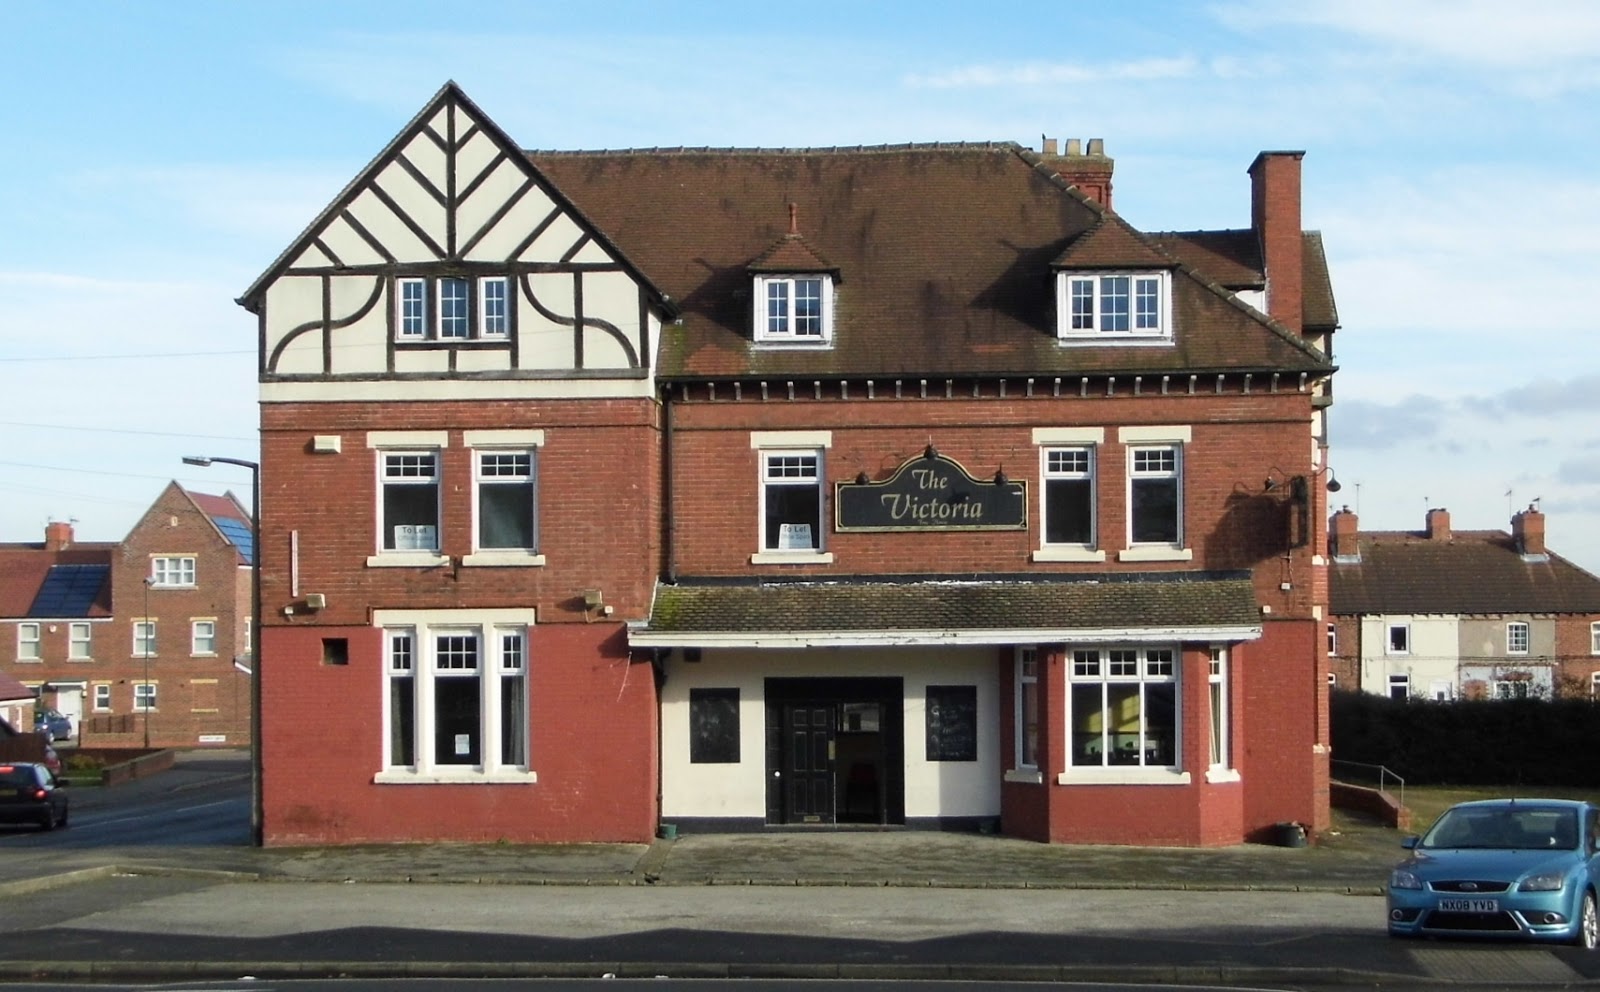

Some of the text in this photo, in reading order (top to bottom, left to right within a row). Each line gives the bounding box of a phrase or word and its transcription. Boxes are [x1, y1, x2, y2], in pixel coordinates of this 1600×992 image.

[911, 469, 948, 489] The
[880, 493, 983, 519] Victoria
[402, 526, 412, 534] To
[783, 525, 807, 533] To Let
[1442, 901, 1470, 910] NX08
